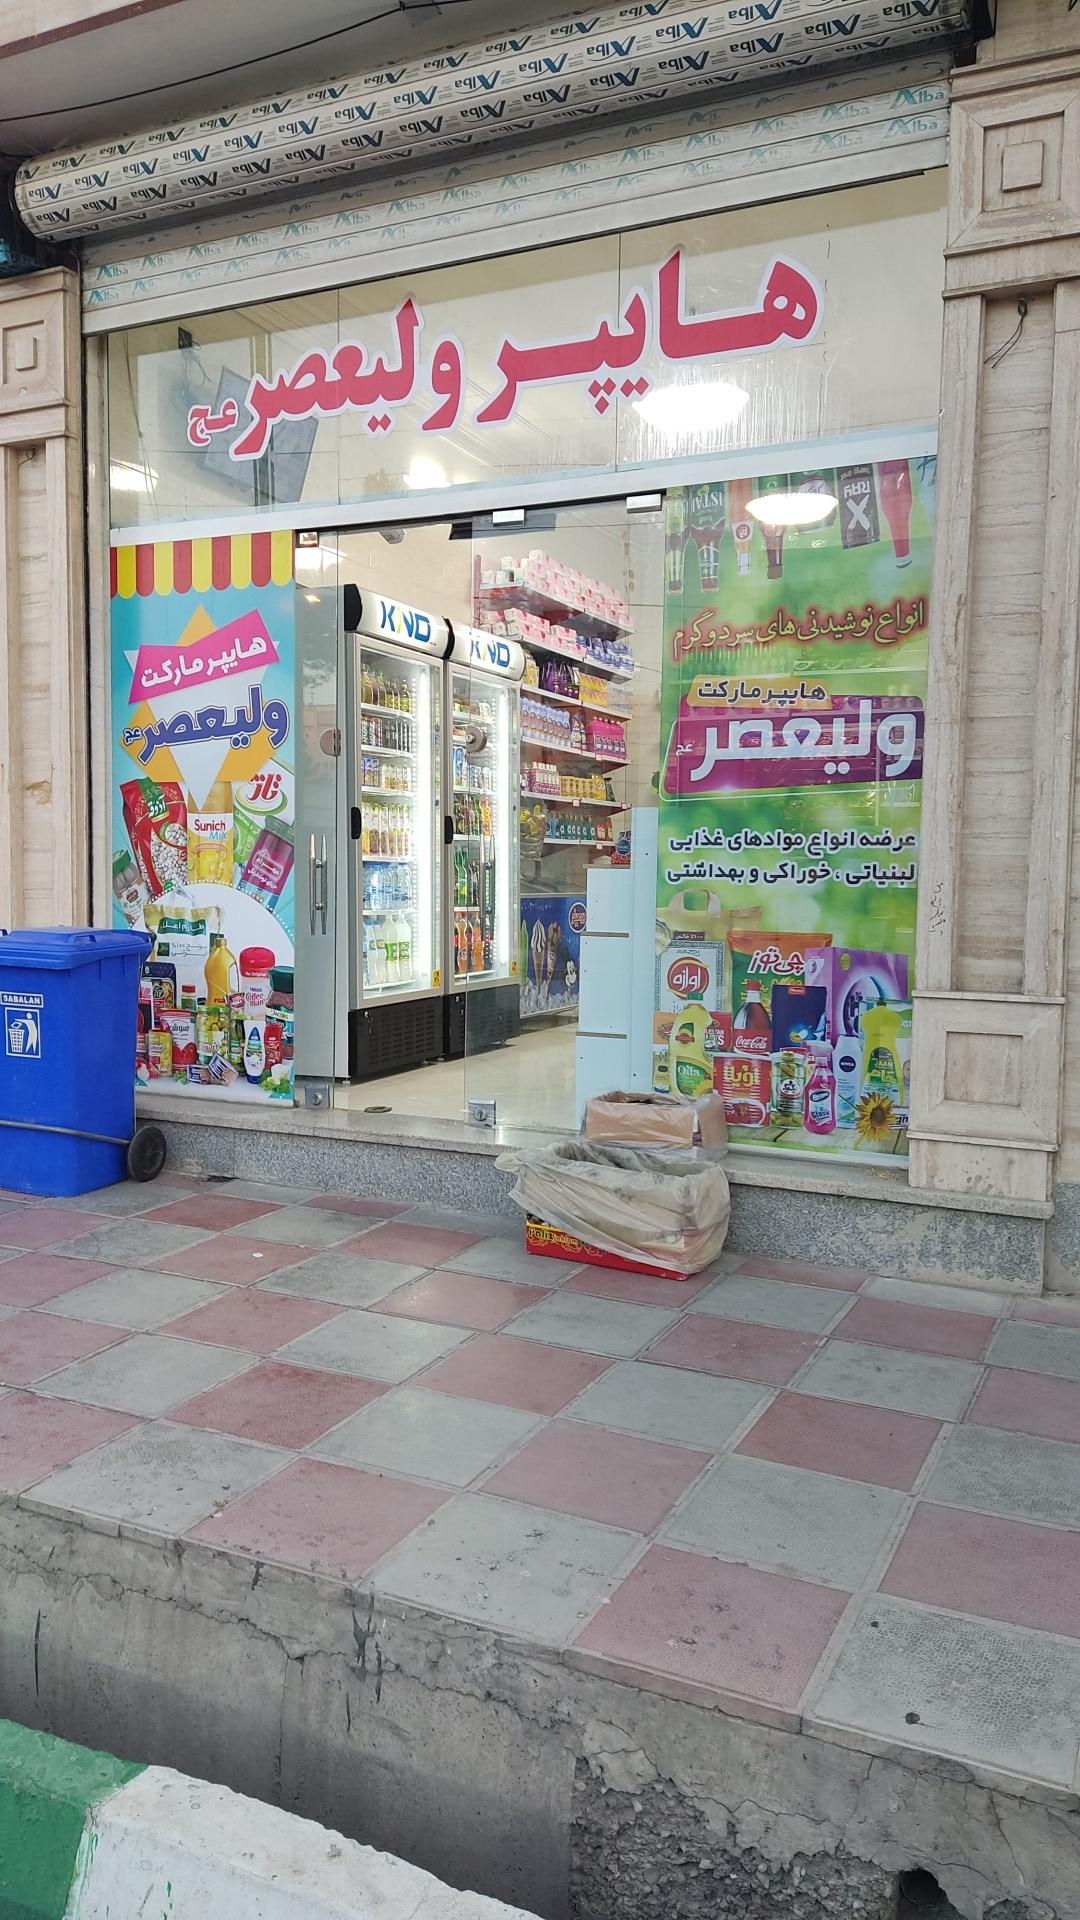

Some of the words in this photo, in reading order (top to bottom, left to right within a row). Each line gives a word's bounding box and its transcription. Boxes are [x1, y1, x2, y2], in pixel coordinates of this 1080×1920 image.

[29, 184, 61, 199] Alba
[75, 171, 109, 188] Alba
[123, 158, 158, 175] Alba
[173, 145, 210, 162] Alba
[224, 130, 263, 149] Alba
[279, 117, 319, 135] Alba
[335, 102, 377, 120] Alba
[393, 86, 437, 105] Alba
[454, 70, 500, 90] Alba
[519, 53, 568, 73] Alba
[587, 36, 636, 57] Alba
[656, 17, 708, 39] Alba
[728, 0, 782, 20] Alba
[52, 154, 86, 169] Alba
[100, 141, 136, 155] Alba
[149, 128, 185, 142] Alba
[200, 113, 238, 129] Alba
[252, 99, 292, 114] Alba
[307, 84, 349, 100] Alba
[364, 68, 407, 85] Alba
[424, 52, 469, 69] Alba
[486, 35, 532, 53] Alba
[551, 20, 598, 35] Alba
[36, 208, 70, 222] Alba
[82, 197, 117, 211] Alba
[131, 184, 167, 199] Alba
[180, 171, 217, 187] Alba
[232, 158, 271, 174] Alba
[285, 145, 325, 161] Alba
[341, 130, 383, 148] Alba
[400, 116, 443, 133] Alba
[460, 100, 506, 118] Alba
[523, 84, 570, 103] Alba
[590, 67, 640, 87] Alba
[658, 50, 710, 70] Alba
[729, 32, 784, 53] Alba
[804, 14, 861, 36] Alba
[883, 0, 939, 17] Alba
[883, 119, 938, 139] Alba
[97, 264, 128, 280] Alba
[889, 88, 945, 111] Alba
[477, 249, 820, 422] هایپر
[233, 297, 463, 457] ولیعصر
[843, 481, 871, 499] RAY
[755, 610, 796, 643] های
[796, 606, 874, 640] نوشیدنی
[874, 599, 925, 645] انواع
[207, 637, 267, 674] هایپر
[141, 655, 204, 688] مارکت
[697, 680, 761, 706] مارکت
[762, 682, 826, 708] هایپر
[138, 684, 290, 765] ولیعصر
[690, 699, 917, 782] ولیعصر
[194, 819, 226, 831] Sunich
[669, 828, 724, 851] غذایی
[807, 831, 855, 856] انواع
[858, 830, 917, 853] عرضه
[667, 861, 745, 885] بهداشتی
[749, 869, 759, 884] و
[762, 862, 831, 885] خوراکی
[845, 863, 915, 886] لبنیاتی
[2, 994, 41, 1005] SABALAN
